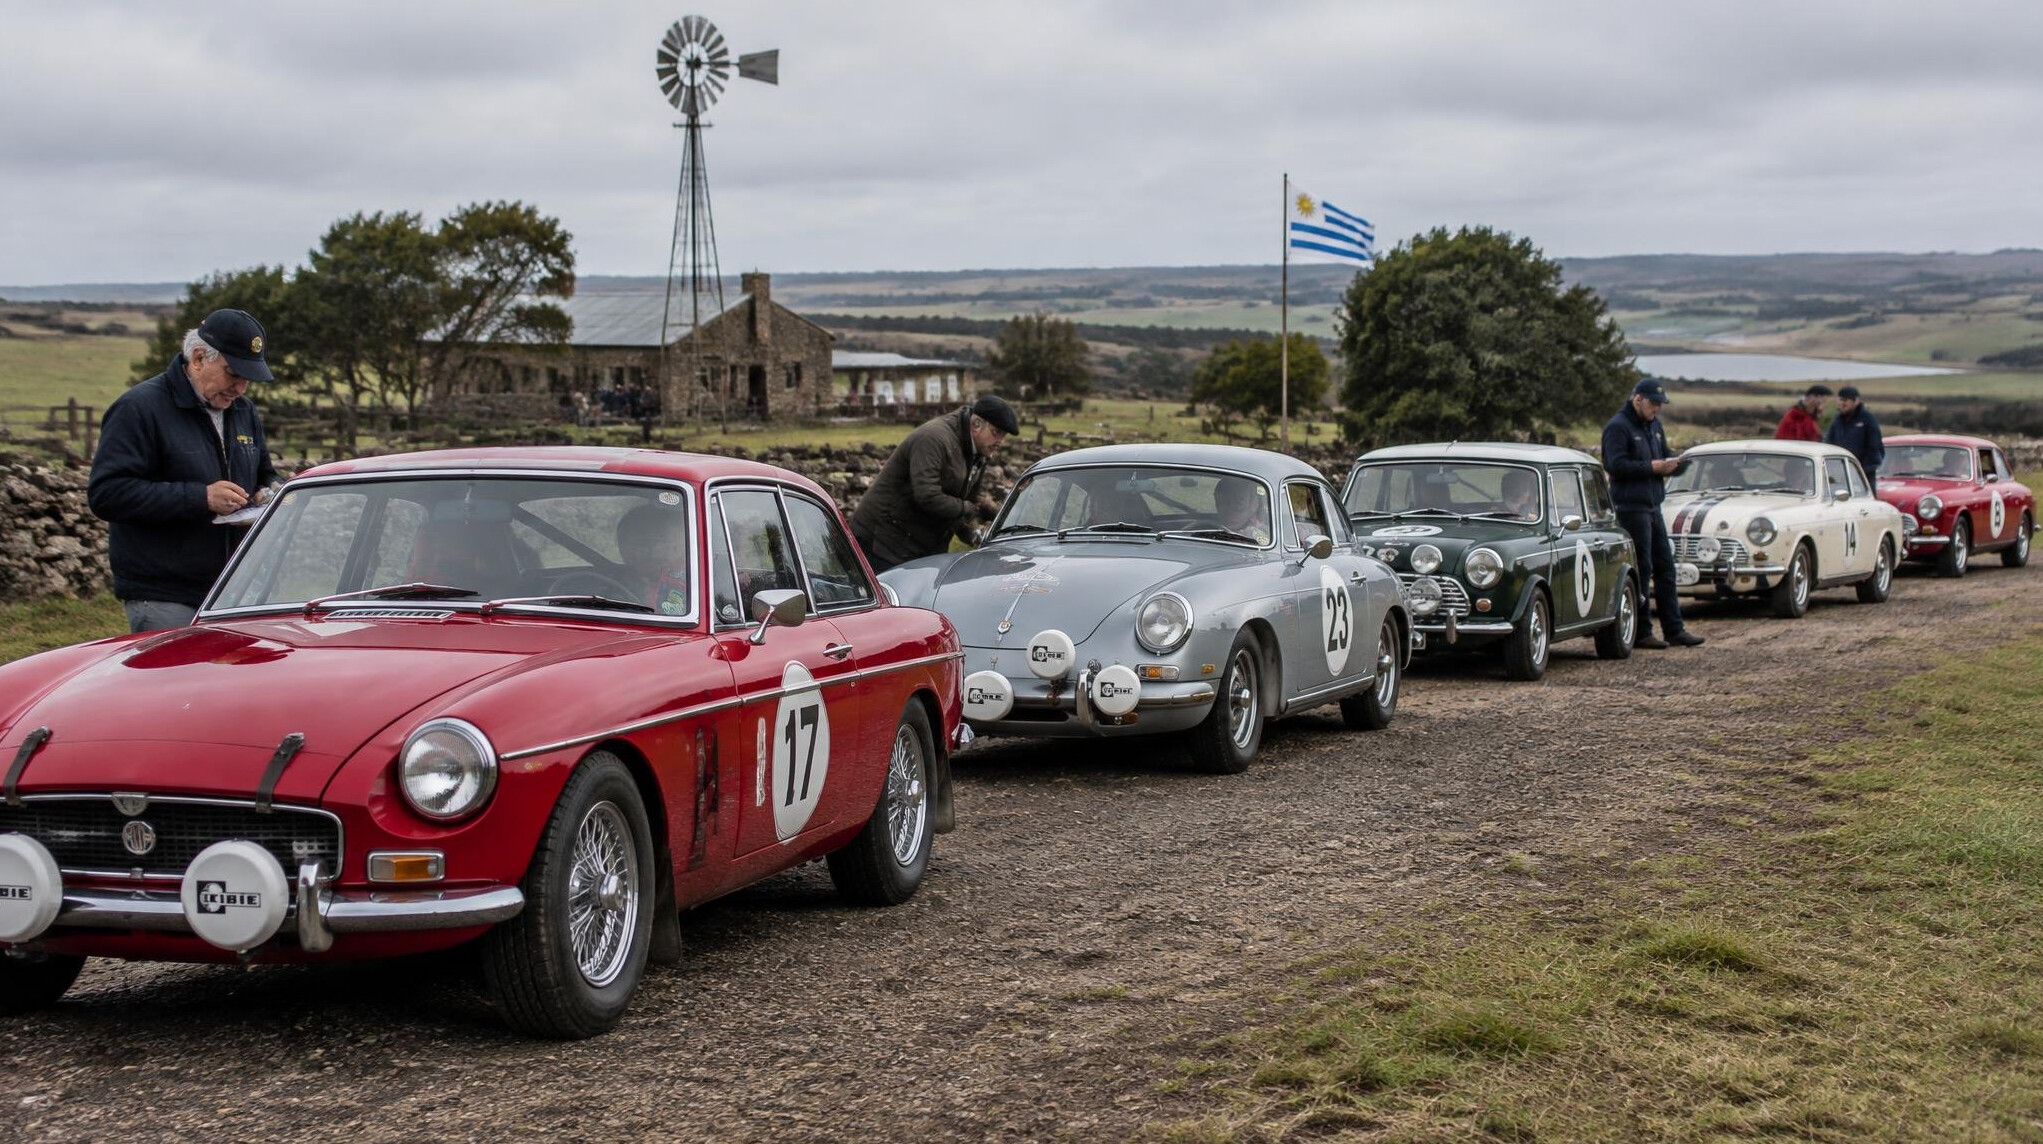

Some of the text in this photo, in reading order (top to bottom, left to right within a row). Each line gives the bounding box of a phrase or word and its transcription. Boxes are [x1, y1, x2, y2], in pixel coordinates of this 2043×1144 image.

[1844, 521, 1856, 557] 14
[1581, 554, 1590, 602] 6
[1326, 586, 1349, 653] 23
[785, 704, 819, 807] 17
